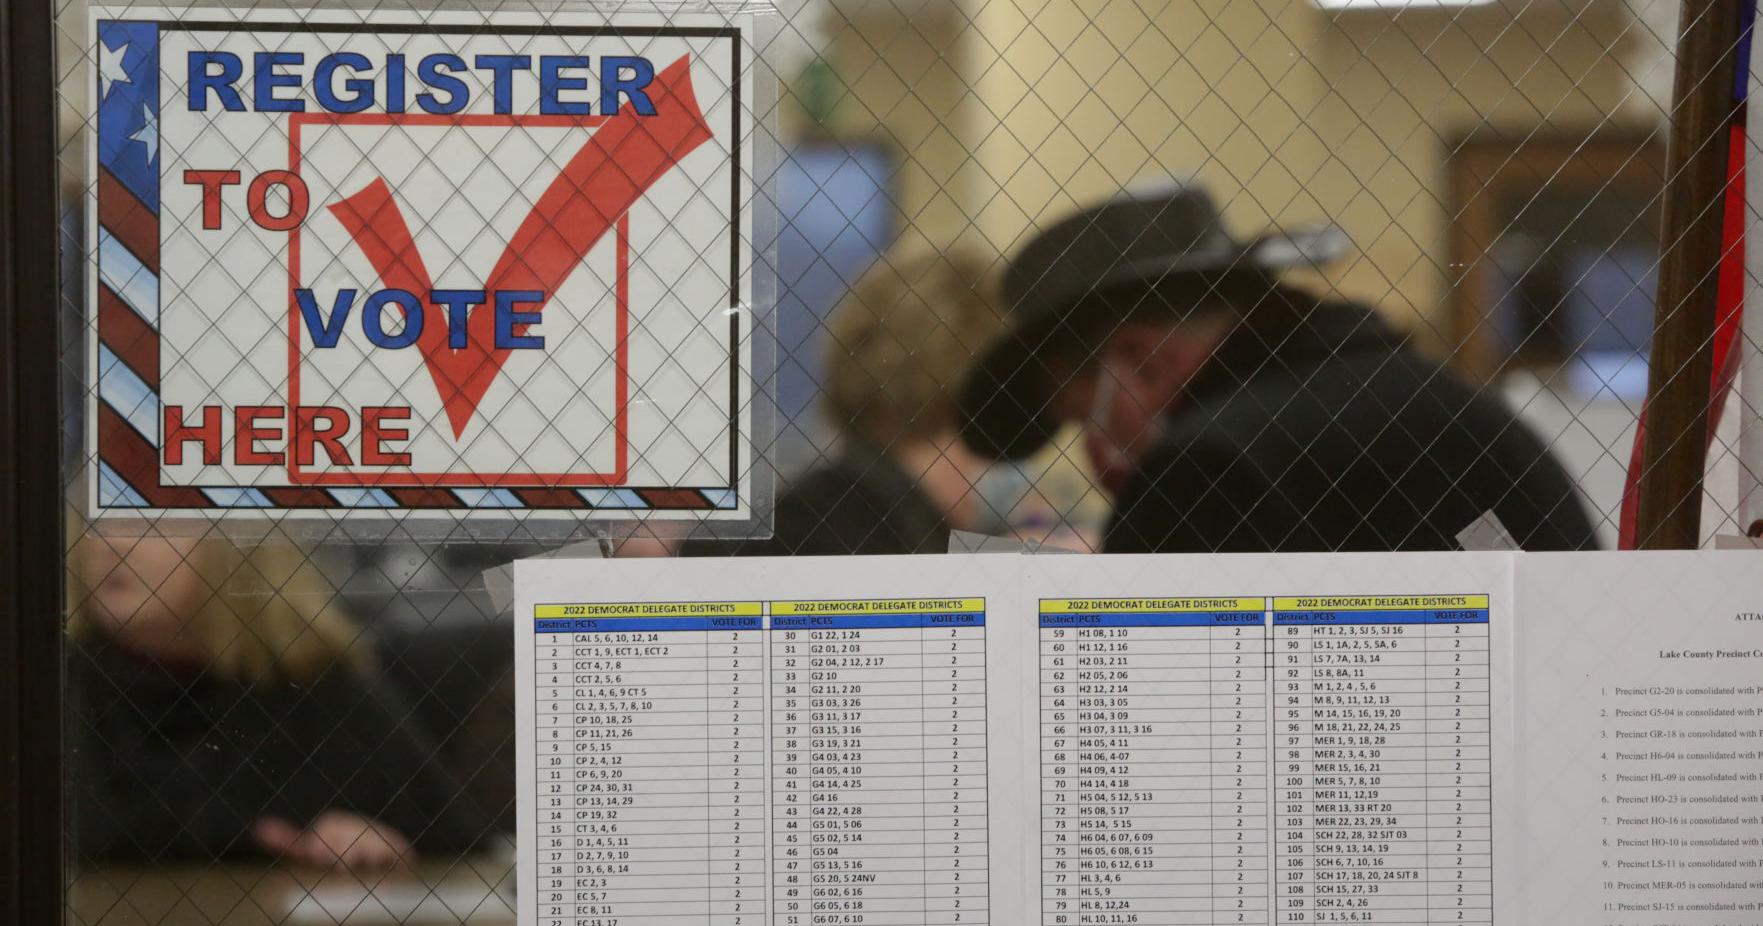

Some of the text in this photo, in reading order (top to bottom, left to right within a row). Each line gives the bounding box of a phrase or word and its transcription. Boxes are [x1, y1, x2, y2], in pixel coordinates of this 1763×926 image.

[187, 50, 658, 117] REGISTER
[183, 169, 310, 232] TO
[293, 287, 546, 350] VOTE
[163, 405, 413, 467] HERE
[793, 600, 963, 612] 2022 DEMOCRAT DELEGATE DISTRICTS
[1067, 599, 1238, 609] 2022 DEMOCRAT DELEGATE DISTRICTS
[1296, 596, 1466, 607] 2022 DEMOCRAT DELEGATE DISTRICTS
[563, 603, 735, 614] 2022 DEMOCRAT DELEGATE DISTRICTS
[773, 613, 974, 626] District PCTS VOTE FOR
[1042, 612, 1259, 624] District PCTS VOTE FOR
[1276, 610, 1478, 621] District PCTS VOTE FOR
[1735, 612, 1763, 621] ATTA
[537, 617, 756, 629] District PCTS VOTE FOR
[551, 645, 738, 657] 2 CCT 1, 9, ECT 1, ECT 2 2
[1659, 649, 1680, 658] Lake
[1682, 649, 1714, 660] County
[1716, 649, 1750, 658] Precinct
[785, 655, 957, 668] 32 G2 04, 2 12, 2 17 2
[1615, 686, 1647, 696] Precinct
[1649, 686, 1675, 695] G2-20
[1676, 687, 1683, 695] is
[1685, 686, 1735, 695] consolidated
[1736, 685, 1755, 695] with
[1287, 707, 1461, 718] 95 M 14, 15, 16, 19, 20 2
[1615, 708, 1647, 717] Precinct
[1648, 707, 1675, 716] G5-04
[1685, 707, 1735, 717] consolidated
[1736, 707, 1755, 716] with
[1053, 723, 1242, 734] 66 H3 07, 3 11, 3 16 2
[1615, 729, 1647, 738] Precinct
[1649, 729, 1677, 738] GR-18
[1687, 728, 1737, 738] consolidated
[1739, 729, 1757, 738] with
[1615, 751, 1647, 760] Precinct
[1650, 751, 1675, 760] H6-04
[1686, 751, 1736, 760] consolidated
[1738, 750, 1756, 759] with
[1616, 773, 1648, 782] Precinct
[1650, 772, 1677, 782] HL-09
[1687, 772, 1737, 782] consolidated
[1739, 772, 1757, 781] with
[550, 780, 740, 793] 12 CP 24, 30, 31 2
[1287, 815, 1462, 826] 103 MER 22, 23, 29, 34 2
[1617, 838, 1649, 847] Precinct
[1651, 837, 1679, 846] HO-10
[1680, 838, 1688, 846] is
[1689, 837, 1740, 847] consolidated
[1740, 837, 1759, 846] with
[786, 872, 959, 884] 48 G5 20, 5 24NV 2
[1287, 883, 1463, 894] 108 SCH 15, 27, 33 2
[1617, 880, 1649, 890] Precinct
[1652, 880, 1686, 889] MER-05
[1697, 879, 1747, 890] consolidated
[1055, 899, 1243, 910] 79 HL 8, 12,24 2
[1617, 902, 1650, 911] Precinct
[1652, 902, 1674, 911] SJ-15
[1685, 901, 1736, 911] consolidated
[1737, 901, 1755, 911] with
